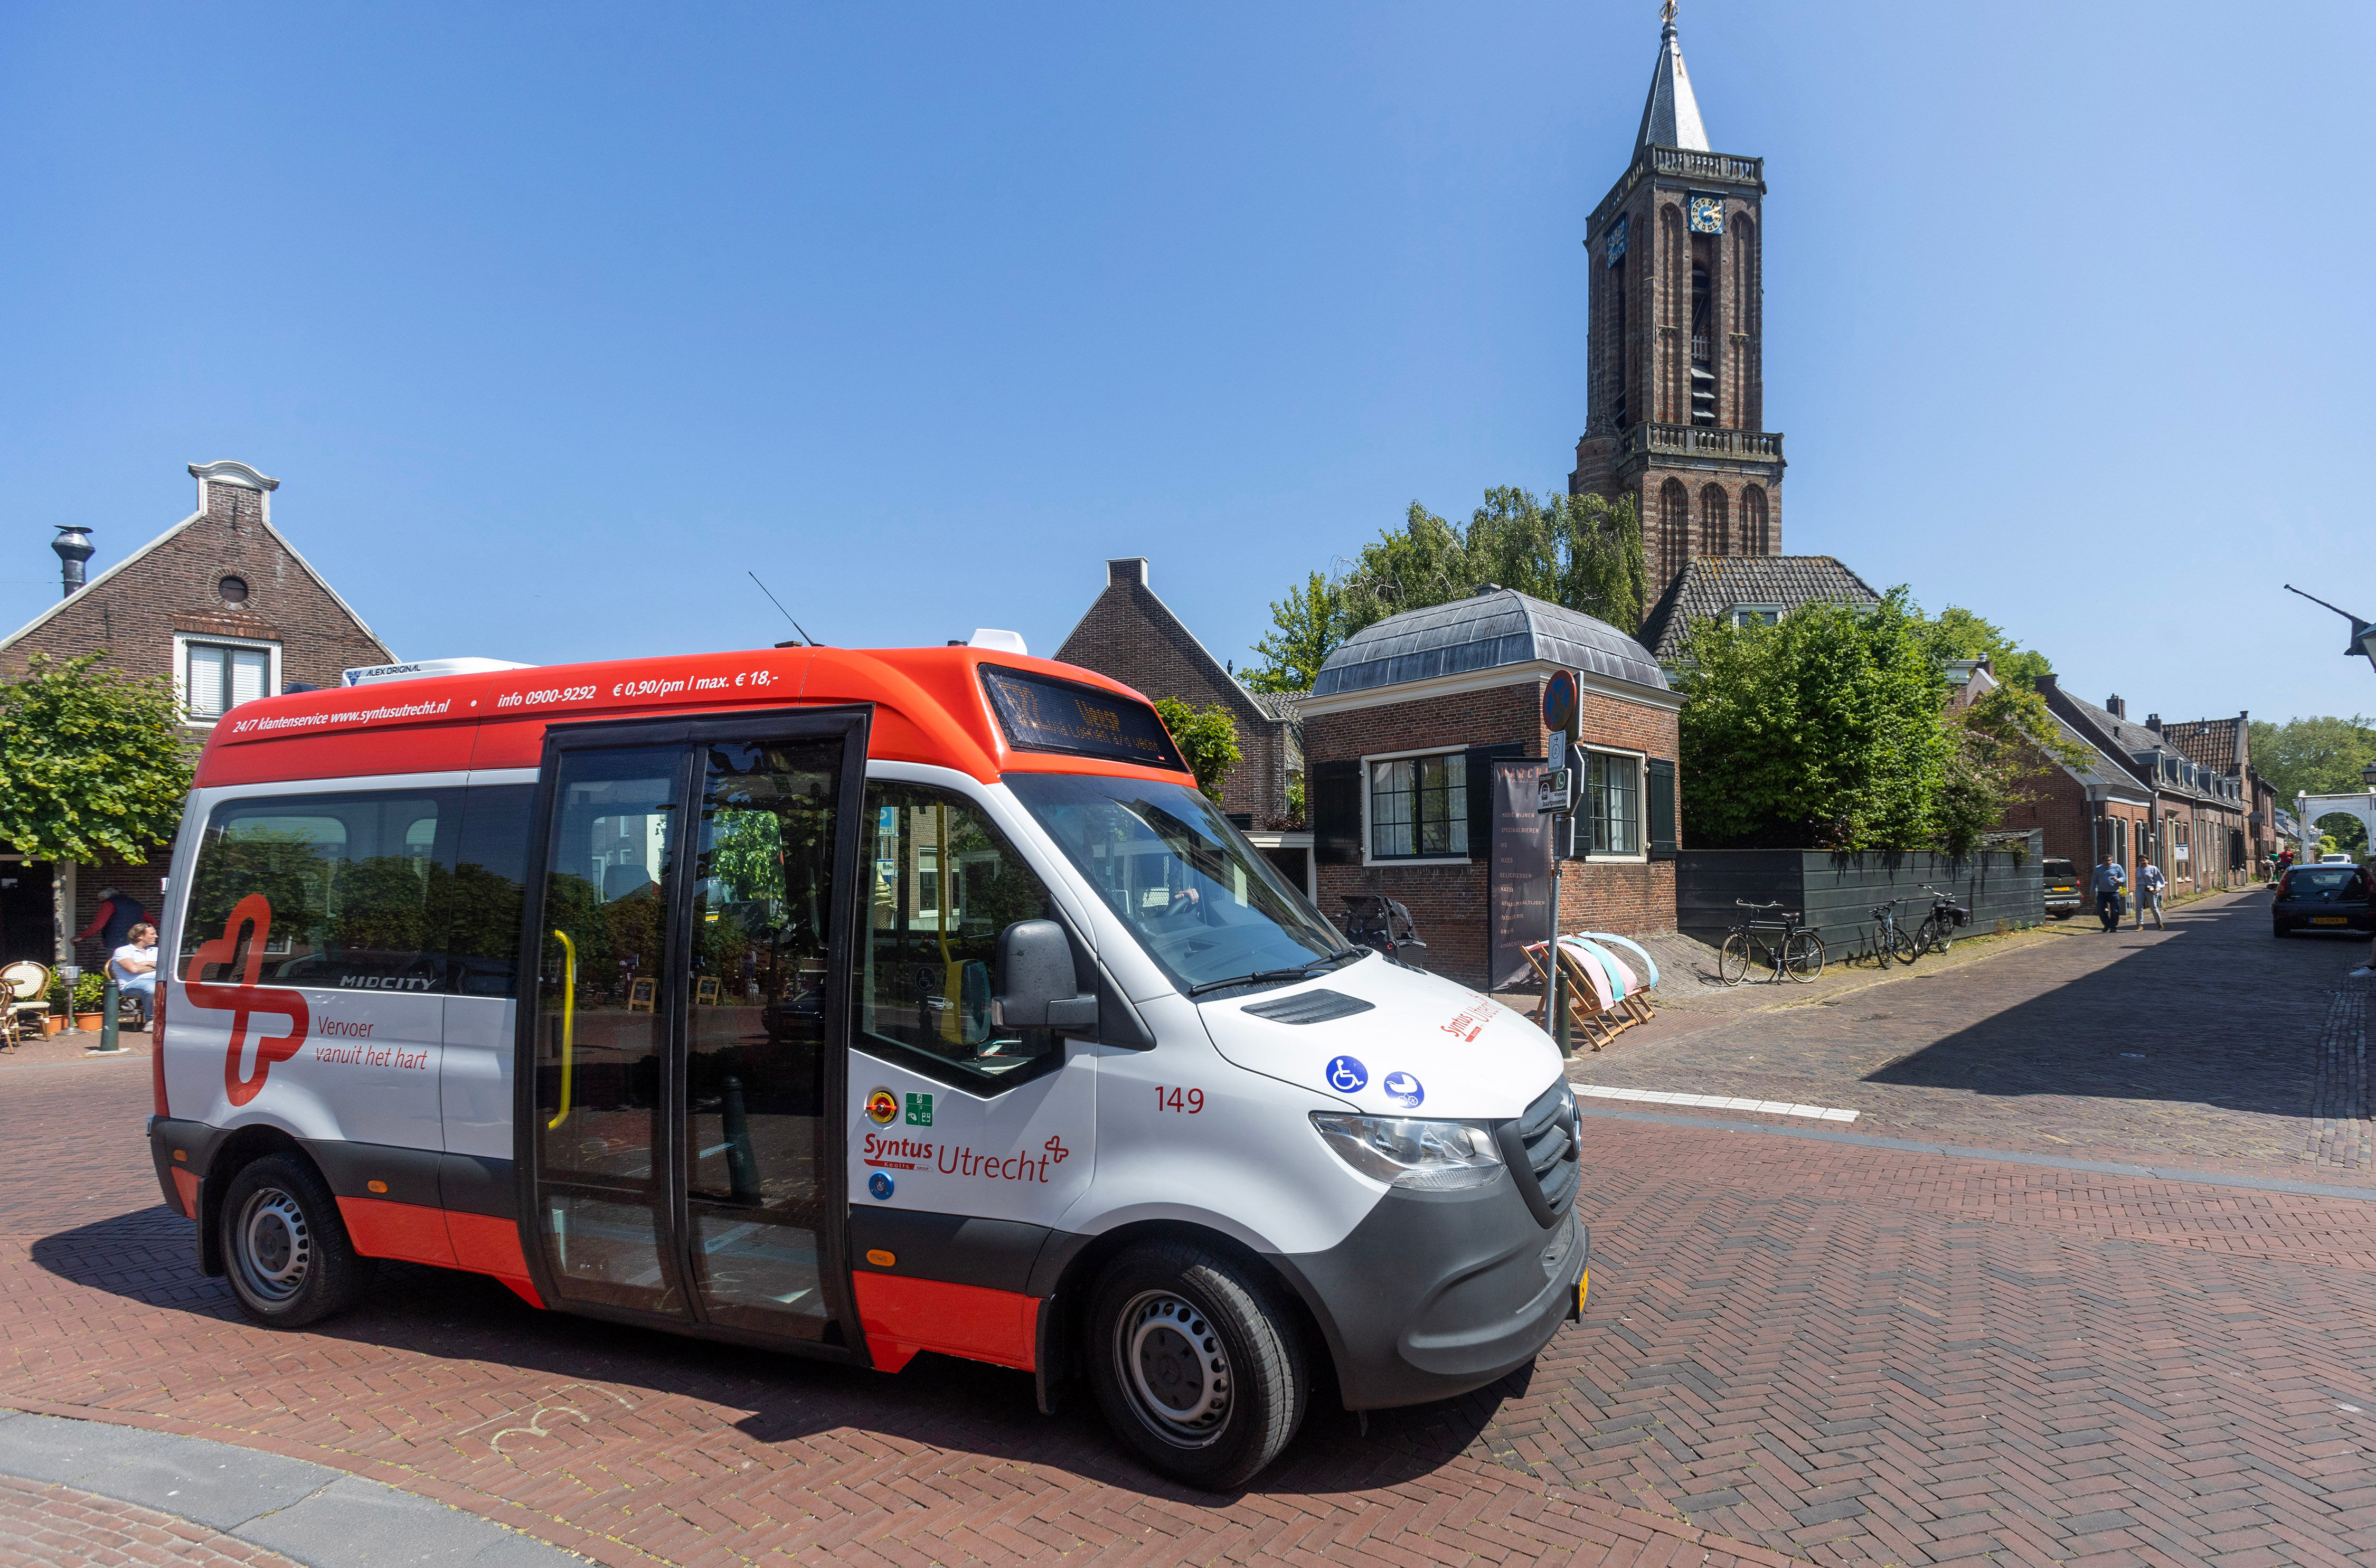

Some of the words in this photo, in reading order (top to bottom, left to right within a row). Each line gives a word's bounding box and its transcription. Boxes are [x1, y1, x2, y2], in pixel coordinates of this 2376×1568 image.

[387, 664, 421, 675] ORIGINAL
[612, 683, 624, 697] €
[625, 679, 684, 697] 0,90/pm
[695, 676, 729, 689] max.
[734, 673, 747, 686] €
[750, 670, 779, 686] 18,-
[497, 692, 521, 707] info
[525, 685, 597, 705] 0900-9292
[233, 719, 258, 733] 24/7
[258, 712, 328, 730] klantenservice
[331, 698, 451, 724] www.syntusutrecht.nl
[1542, 798, 1567, 807] buurtpreventie
[340, 975, 437, 990] MIDCITY
[318, 1016, 374, 1038] Vervoer
[1440, 1013, 1474, 1037] Syntus
[316, 1046, 362, 1065] vanuit
[365, 1045, 391, 1067] het
[394, 1047, 428, 1070] hart
[1155, 1086, 1204, 1114] 149
[864, 1133, 932, 1160] Syntus
[938, 1145, 1049, 1183] Utrecht
